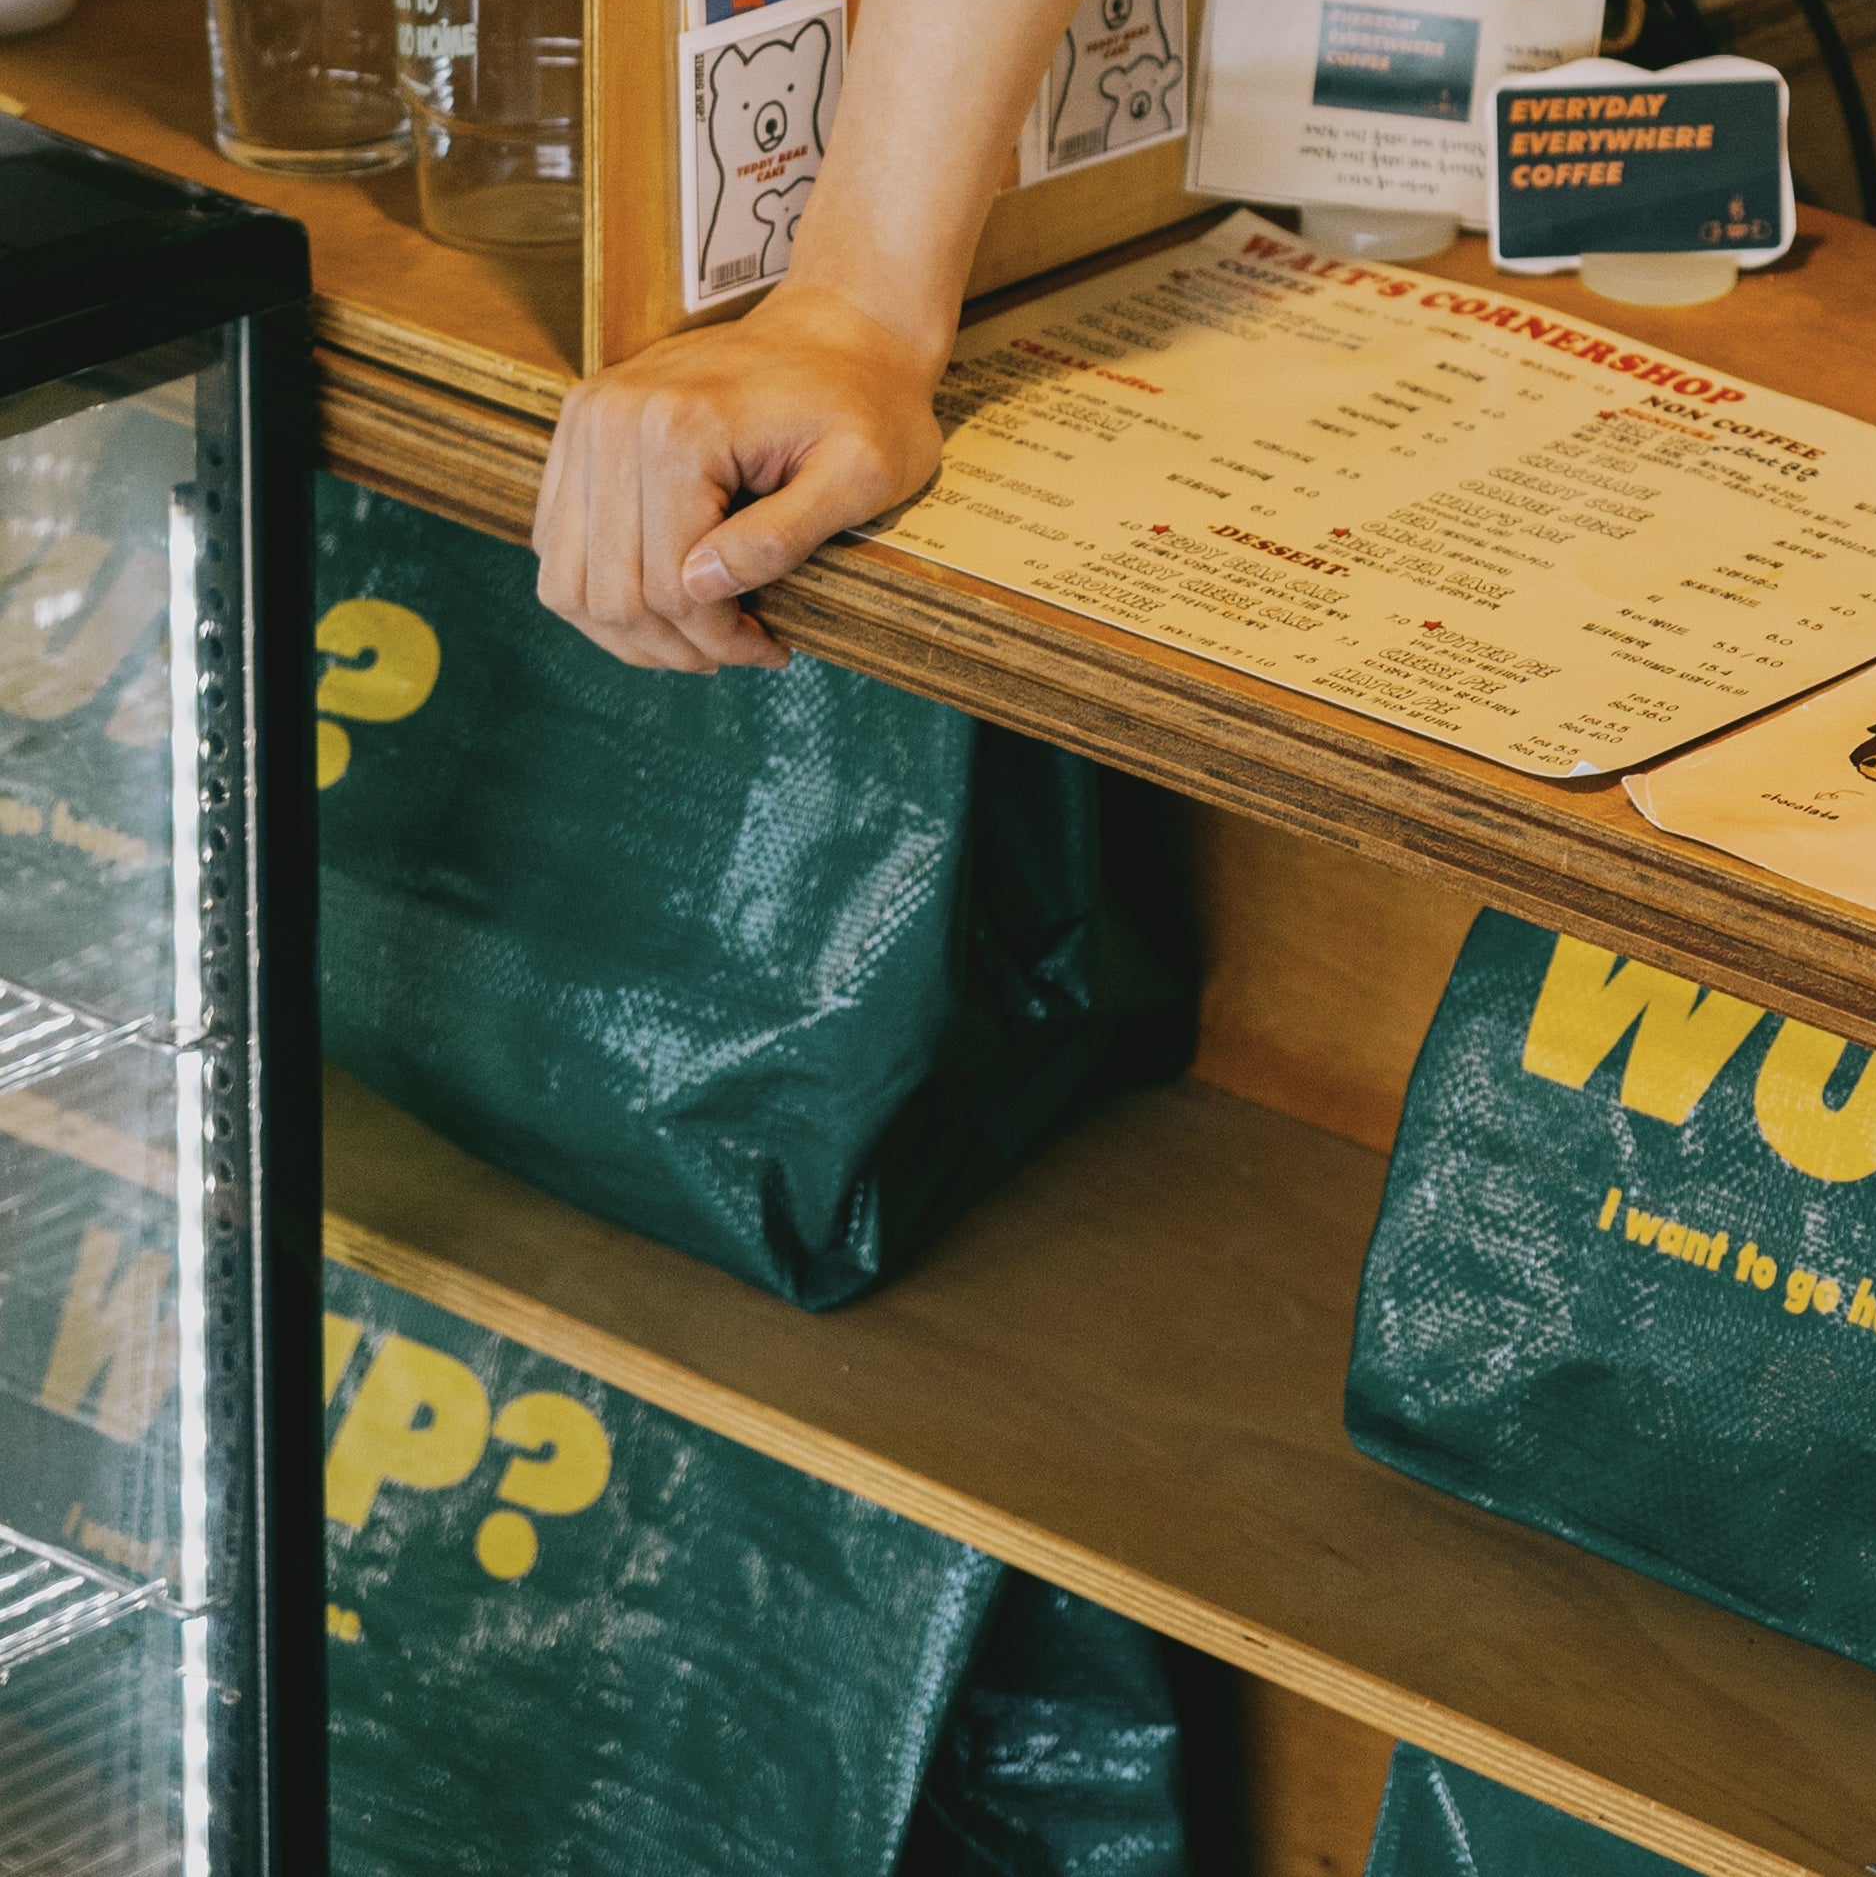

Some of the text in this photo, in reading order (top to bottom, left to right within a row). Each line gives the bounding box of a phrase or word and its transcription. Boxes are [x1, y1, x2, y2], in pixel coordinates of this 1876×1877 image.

[1508, 93, 1668, 126] EVERYDAY
[1508, 123, 1715, 158] EVERYWHERE
[1509, 160, 1625, 191] COFFEE
[1241, 233, 1418, 300] WALT'S
[1418, 290, 1748, 409] CORNERSHOP
[1640, 394, 1713, 422] NON
[1711, 416, 1828, 462] COFFEE
[1764, 632, 1794, 648] 6.0
[1795, 617, 1825, 632] 5.5
[1512, 657, 1562, 680] PIE
[1458, 673, 1508, 697] PIE
[1412, 694, 1463, 716] PIE
[1759, 789, 1841, 823] chocolate
[1595, 1189, 1624, 1234] I
[1625, 1207, 1731, 1284] want
[1734, 1241, 1780, 1292] to
[1784, 1267, 1842, 1318] go
